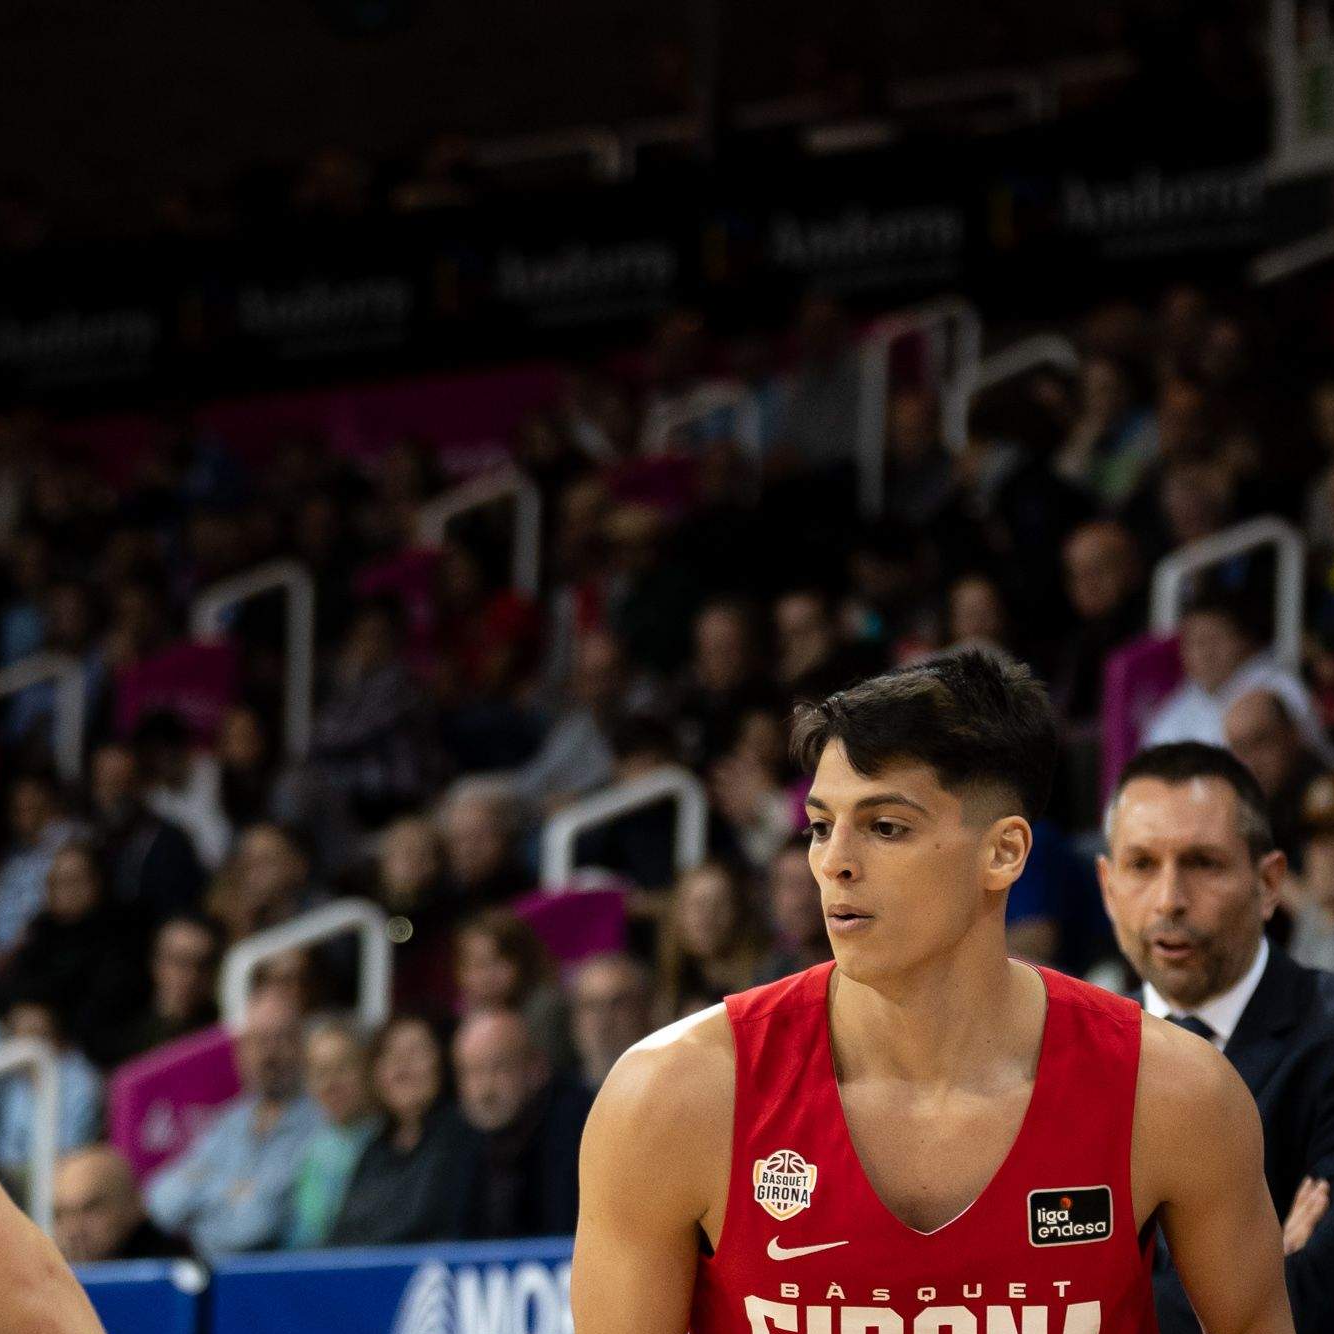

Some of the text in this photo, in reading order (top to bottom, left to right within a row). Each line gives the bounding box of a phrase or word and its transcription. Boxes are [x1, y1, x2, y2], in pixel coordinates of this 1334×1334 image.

[757, 1185, 809, 1205] GIRONA
[1037, 1207, 1069, 1225] liga
[1037, 1221, 1107, 1239] endesa
[780, 1280, 1071, 1302] BÀSQUET
